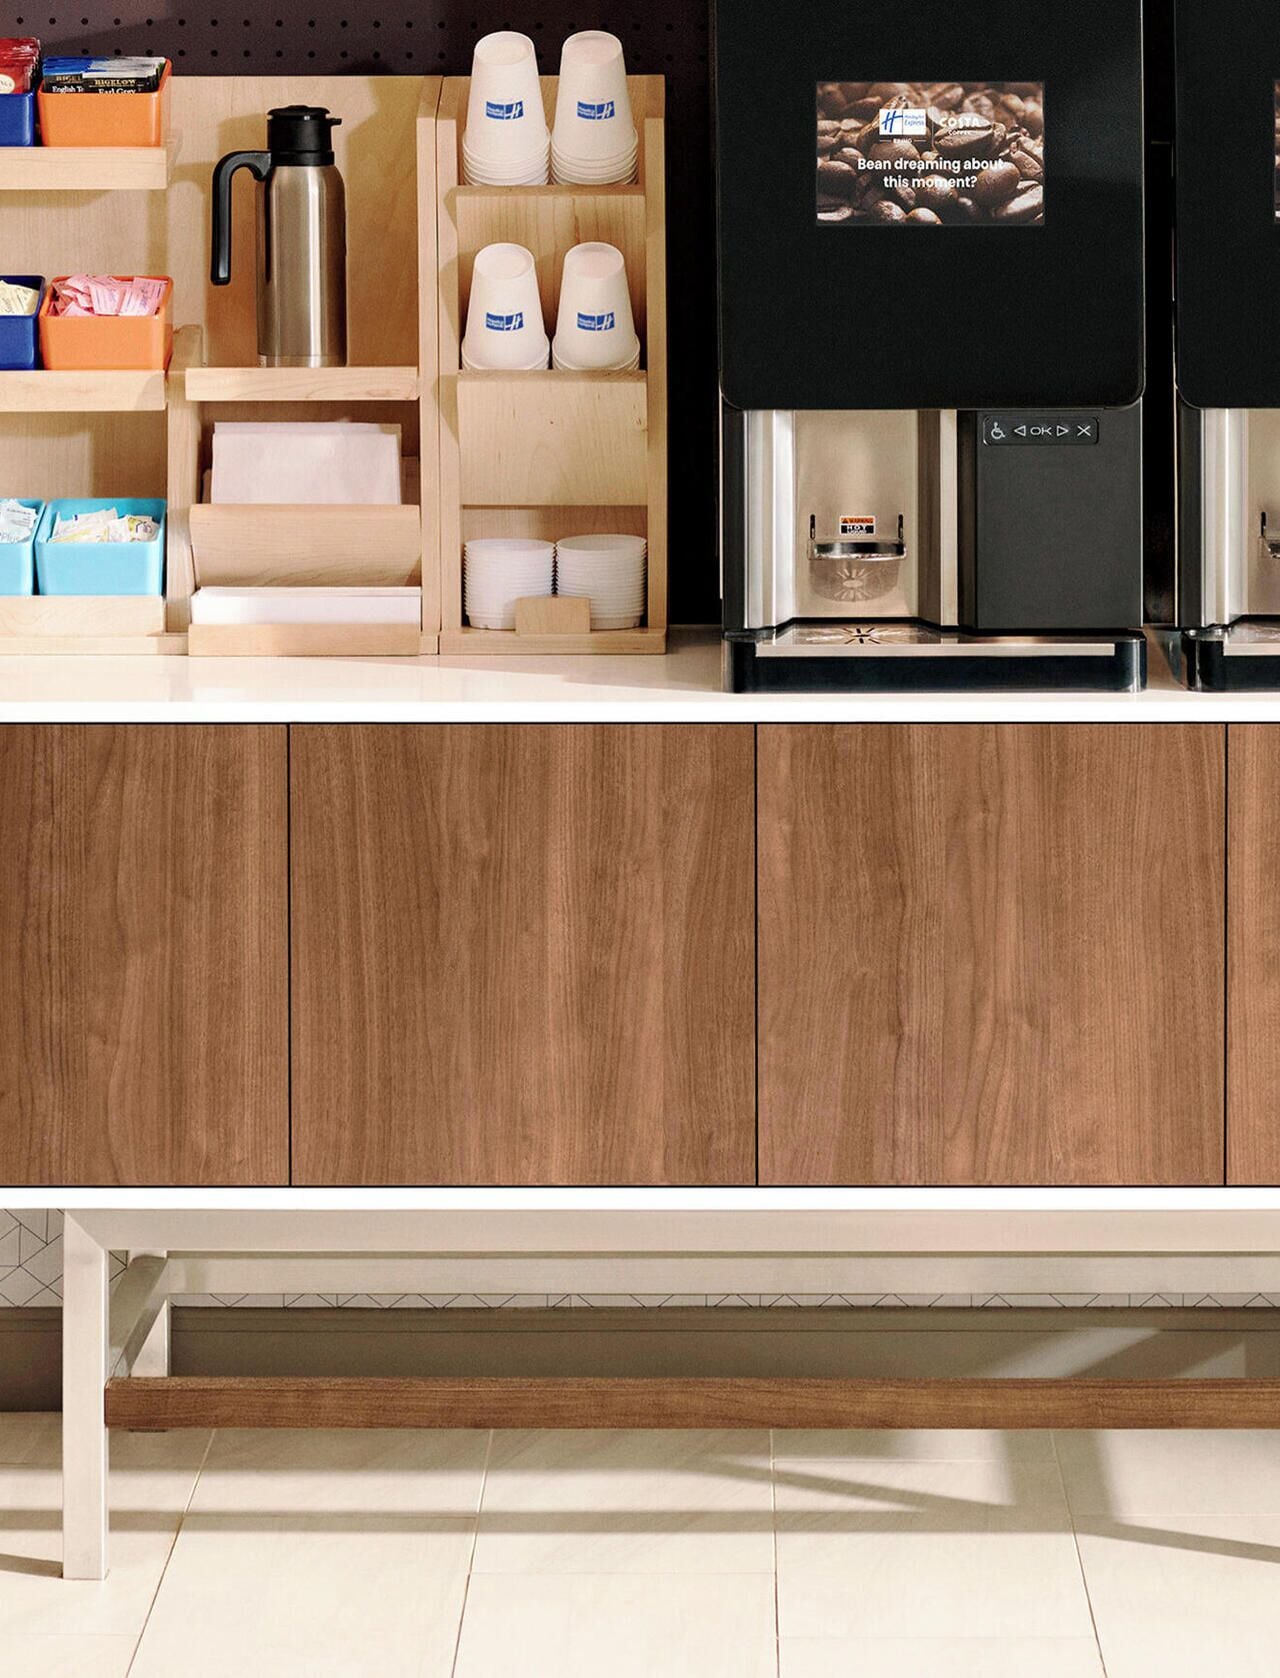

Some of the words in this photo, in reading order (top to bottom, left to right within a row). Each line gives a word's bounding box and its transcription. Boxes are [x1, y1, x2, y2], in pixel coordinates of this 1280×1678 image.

[52, 85, 76, 94] English
[939, 117, 980, 129] COSTA
[858, 158, 892, 170] Bean
[894, 158, 961, 173] dreaming
[963, 158, 1003, 170] about
[883, 176, 909, 188] this
[911, 176, 978, 188] moment?
[1030, 426, 1052, 435] OK
